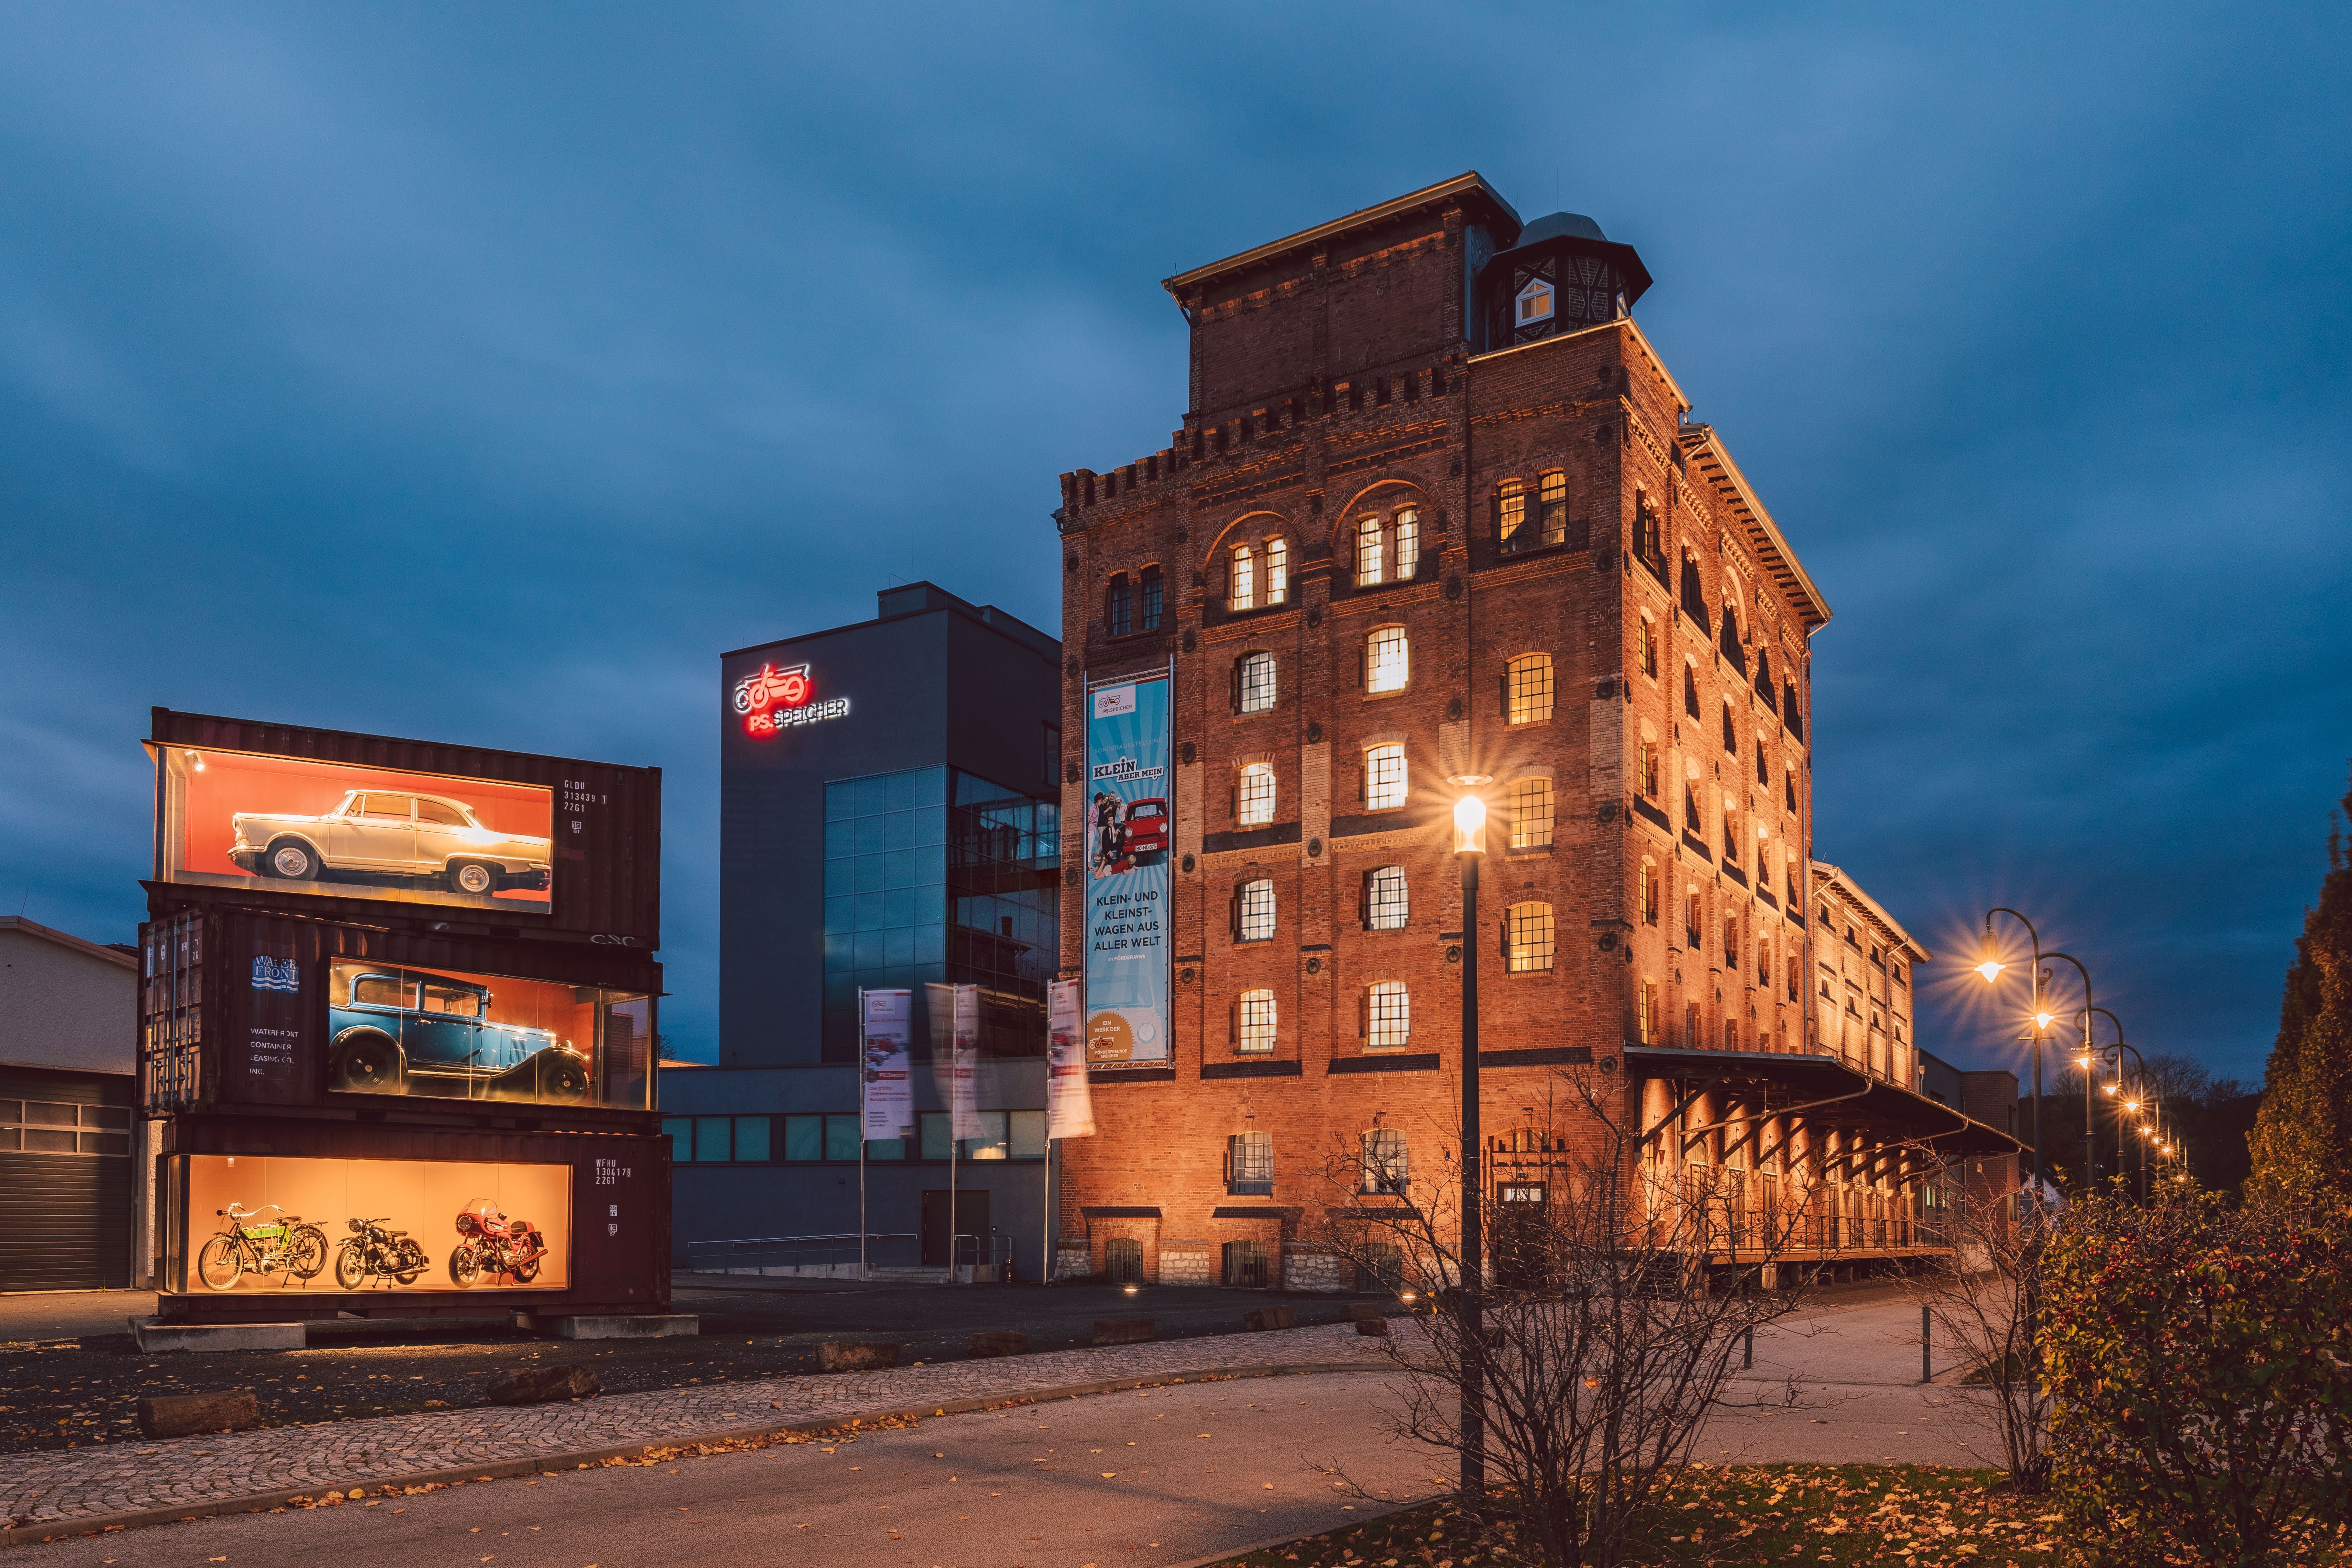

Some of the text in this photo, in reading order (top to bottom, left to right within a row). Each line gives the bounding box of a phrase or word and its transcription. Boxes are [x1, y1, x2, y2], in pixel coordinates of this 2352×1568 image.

[1103, 704, 1132, 713] PS.SPEICHER
[750, 699, 846, 731] PS.SPEICHER
[1094, 738, 1163, 753] SONDERAUSSTELLUNG
[1118, 768, 1162, 780] ABER MEIN
[565, 780, 585, 790] GLDU
[565, 791, 595, 802] 313439
[564, 802, 584, 812] 22G1
[1097, 891, 1158, 907] KLEIN- UND
[1105, 907, 1152, 920] KLEINST-
[1094, 921, 1159, 936] WAGEN AUS
[1094, 936, 1161, 951] ALLER WELT
[256, 966, 297, 980] FRONT
[251, 1042, 291, 1050] CONTAINER
[596, 1168, 626, 1176] 130417
